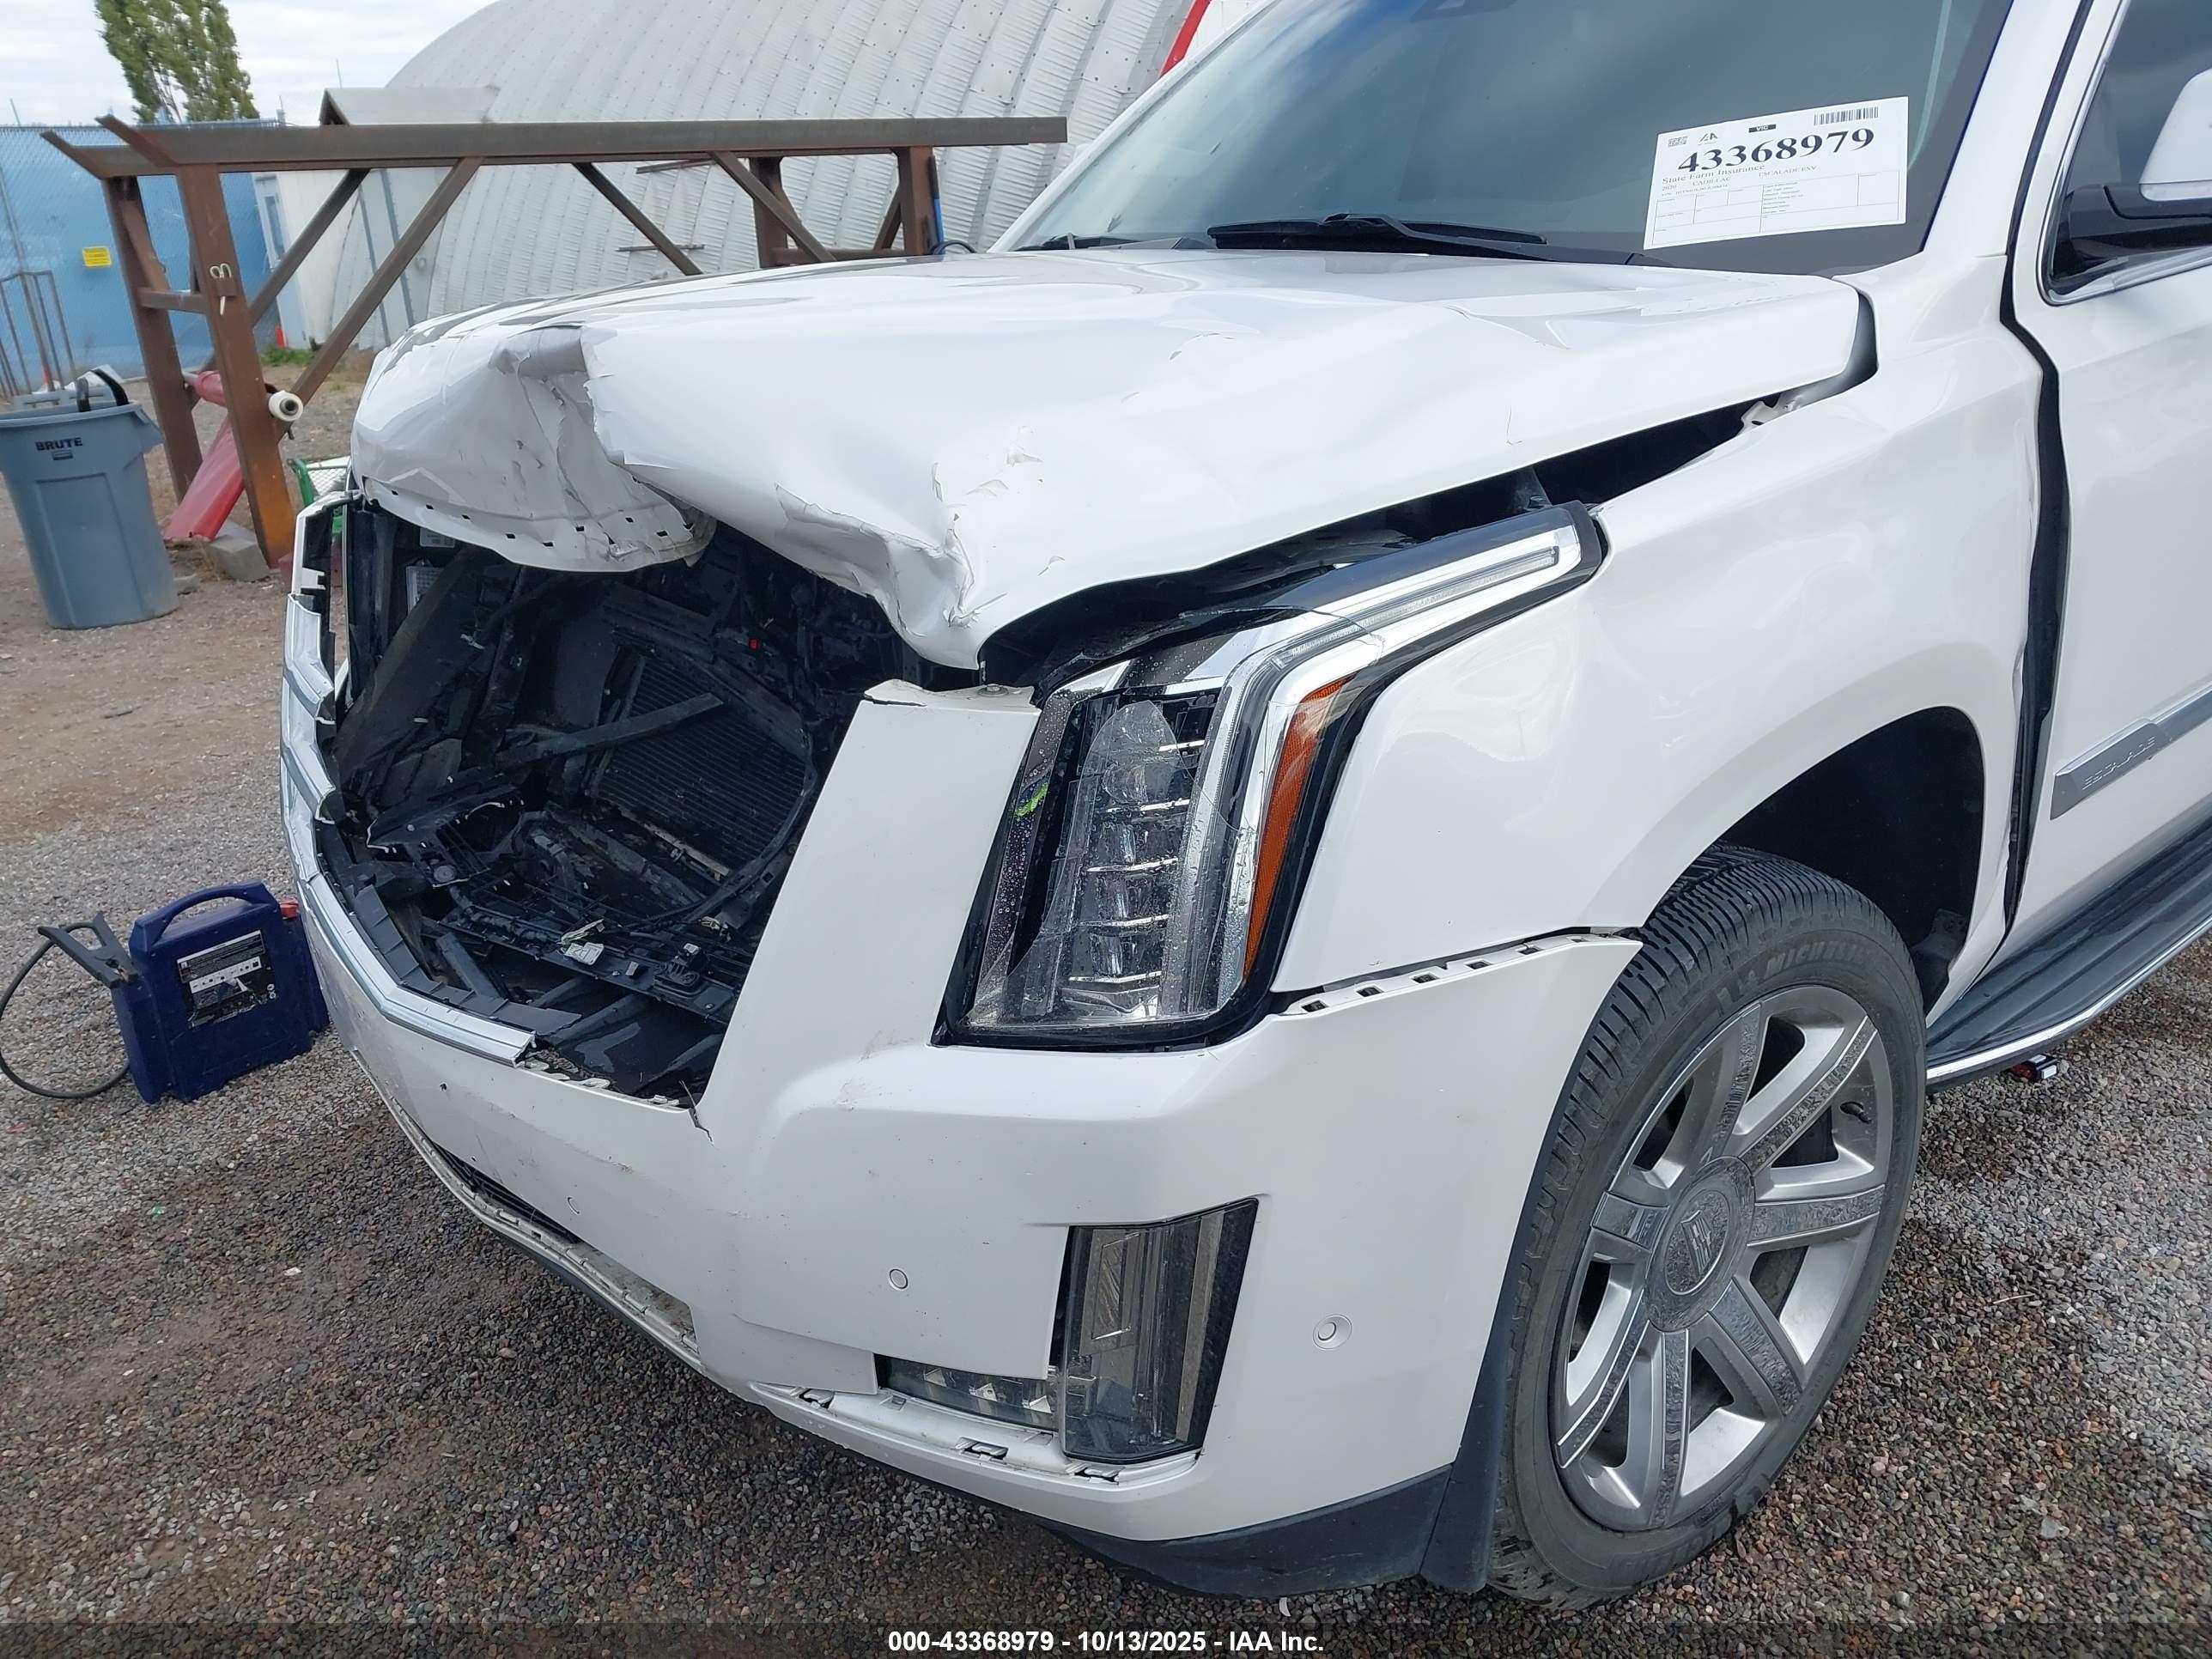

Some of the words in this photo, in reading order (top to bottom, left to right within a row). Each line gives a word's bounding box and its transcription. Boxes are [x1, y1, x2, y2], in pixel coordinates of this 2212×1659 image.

[1678, 128, 1875, 173] 43368979
[1662, 175, 1686, 185] State
[1689, 171, 1714, 180] Farm
[1717, 165, 1765, 177] Insurance
[35, 437, 83, 452] BRUTE
